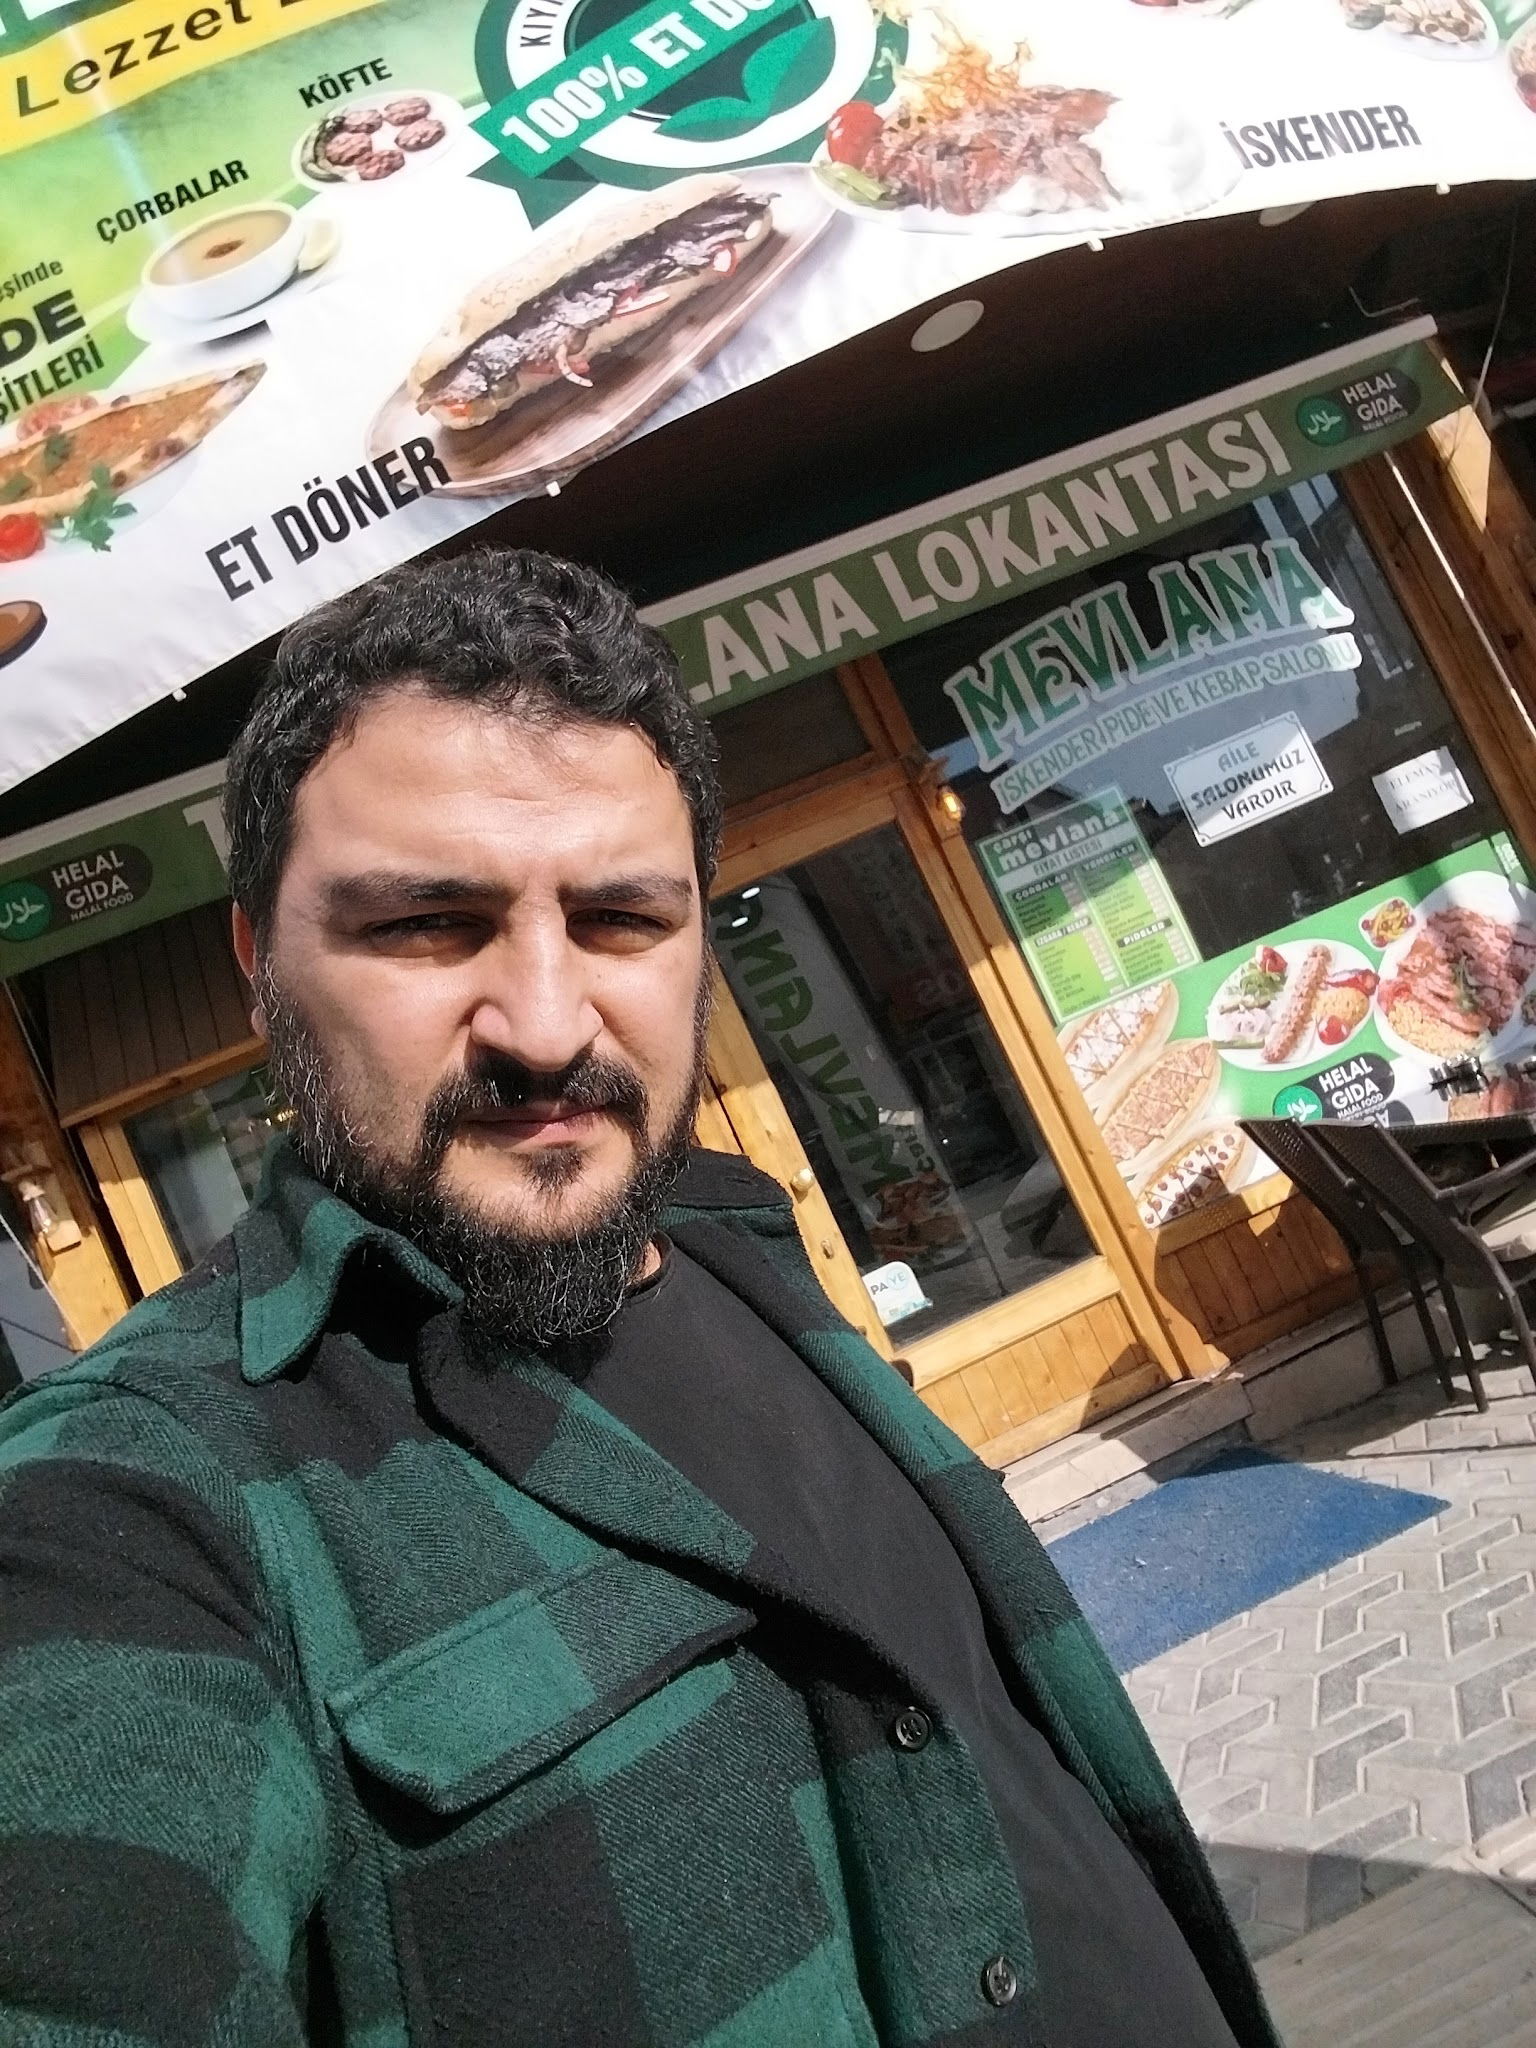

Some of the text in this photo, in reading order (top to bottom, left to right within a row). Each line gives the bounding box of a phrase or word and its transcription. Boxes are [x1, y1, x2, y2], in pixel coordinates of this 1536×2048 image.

[519, 0, 564, 48] KIY
[15, 0, 252, 118] Lezzet
[500, 0, 777, 155] 100% ET D
[298, 57, 393, 110] KÖFTE
[1219, 104, 1423, 170] İSKENDER
[96, 158, 250, 244] ÇORBALAR
[0, 259, 64, 300] şinde
[1341, 372, 1398, 405] HELAL
[1356, 394, 1404, 422] GIDA
[205, 436, 453, 602] ET DÖNER
[872, 410, 1293, 623] LOKANTASI
[951, 544, 1345, 762] MEVLANA
[1152, 684, 1190, 719] VE
[1186, 660, 1262, 706] KEBAP
[1262, 640, 1356, 681] SALONU
[1190, 748, 1306, 810] SALONUMUZ
[1217, 740, 1261, 773] AİLE
[1221, 779, 1298, 821] VARDIR
[999, 809, 1121, 872] mevlana
[51, 849, 125, 889] HELAL
[65, 873, 130, 911] GIDA
[70, 891, 134, 922] HALAL FOOD
[1318, 1056, 1374, 1094] HELAL
[1330, 1077, 1381, 1111] GIDA
[1360, 1092, 1384, 1111] FOOD
